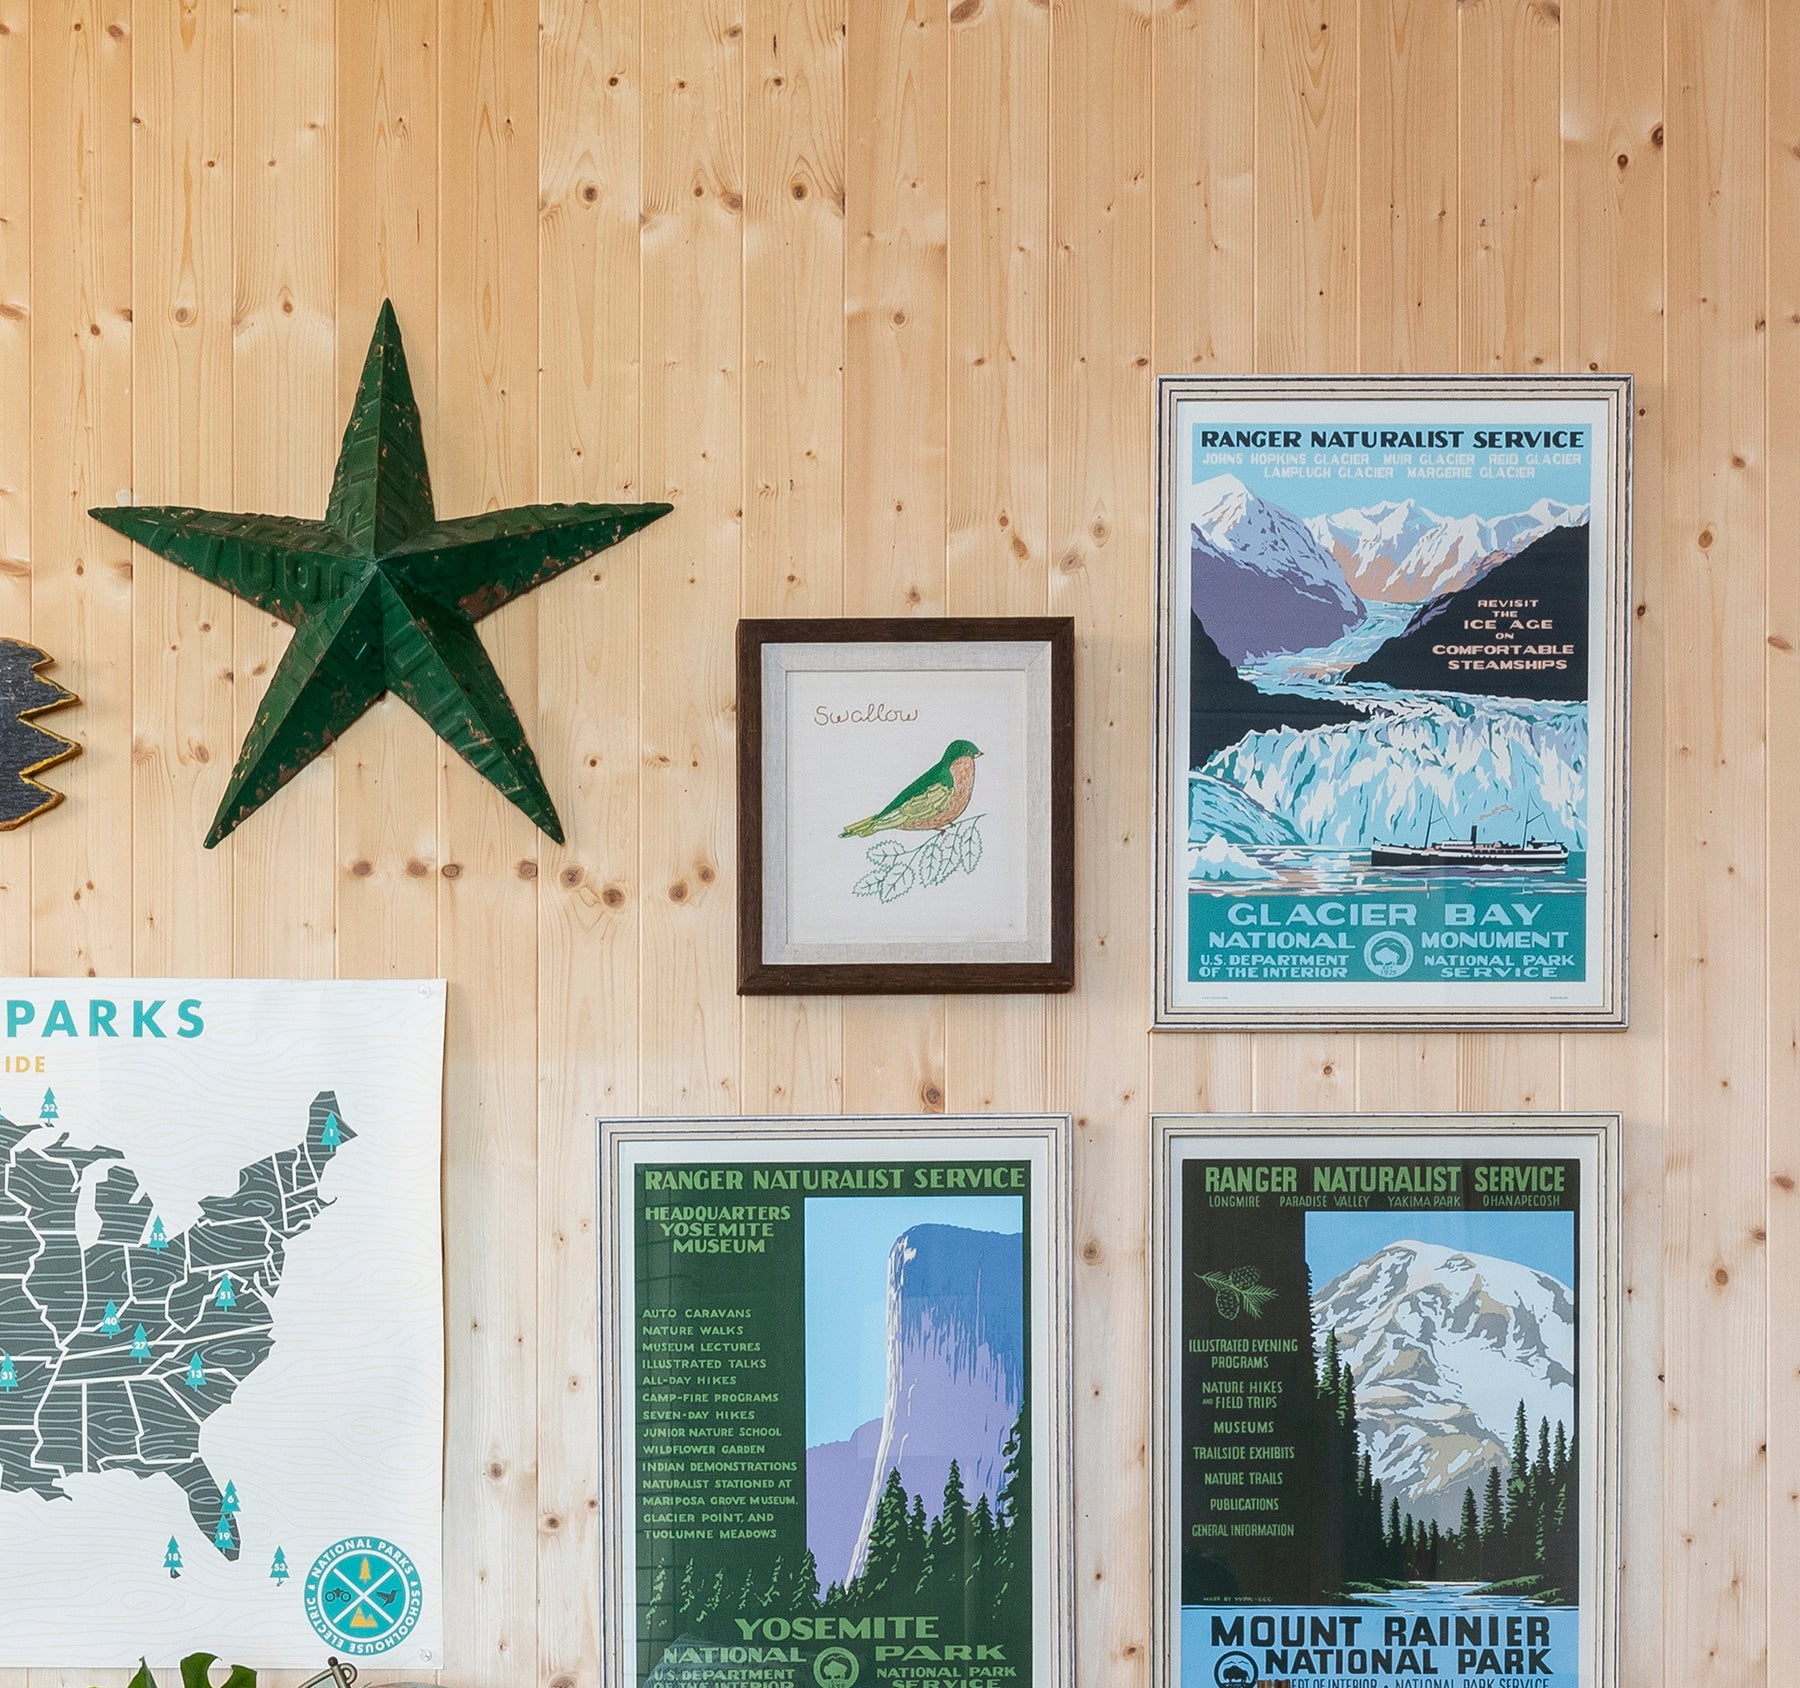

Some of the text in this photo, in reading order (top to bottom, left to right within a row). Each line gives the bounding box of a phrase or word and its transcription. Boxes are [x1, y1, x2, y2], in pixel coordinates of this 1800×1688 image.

[1201, 430, 1584, 448] RANGER NATURALIST SERVICE
[1477, 600, 1539, 608] REVISIT
[1464, 619, 1553, 629] ICE AGE
[1432, 645, 1574, 655] COMFORTABLE
[1448, 660, 1567, 670] STEAMSHIPS
[814, 703, 920, 726] Swallow
[1227, 903, 1543, 926] GLACIER BAY
[1209, 931, 1356, 948] NATIONAL
[1422, 931, 1570, 948] MONUMENT
[6, 998, 204, 1040] PARKS
[644, 1167, 1026, 1191] RANGER NATURALIST SERVICE
[1205, 1166, 1565, 1192] RANGER NATURALIST SERVICE
[1209, 1196, 1261, 1207] LONGMIRE
[644, 1205, 791, 1223] HEADQUARTERS
[660, 1222, 774, 1237] YOSEMITE
[672, 1238, 766, 1254] MUSEUM
[642, 1309, 752, 1318] AUTO CARAVANS
[642, 1326, 743, 1335] NATURE WALKS
[642, 1343, 761, 1351] MUSEUM LECTURES
[1202, 1381, 1283, 1394] NATURE HIKES
[1214, 1421, 1274, 1433] MUSEUMS
[1193, 1447, 1295, 1459] TRAILSIDE EXHIBITS
[312, 1539, 414, 1579] NATIONAL PARKS
[307, 1597, 345, 1648] ELECTRIC
[349, 1589, 421, 1653] SCHOOLHOUSE
[734, 1616, 939, 1641] YOSEMITE
[1211, 1616, 1552, 1647] MOUNT RAINIER
[664, 1647, 807, 1663] NATIONAL
[875, 1644, 1006, 1661] PARK
[1265, 1649, 1554, 1674] NATIONAL PARK
